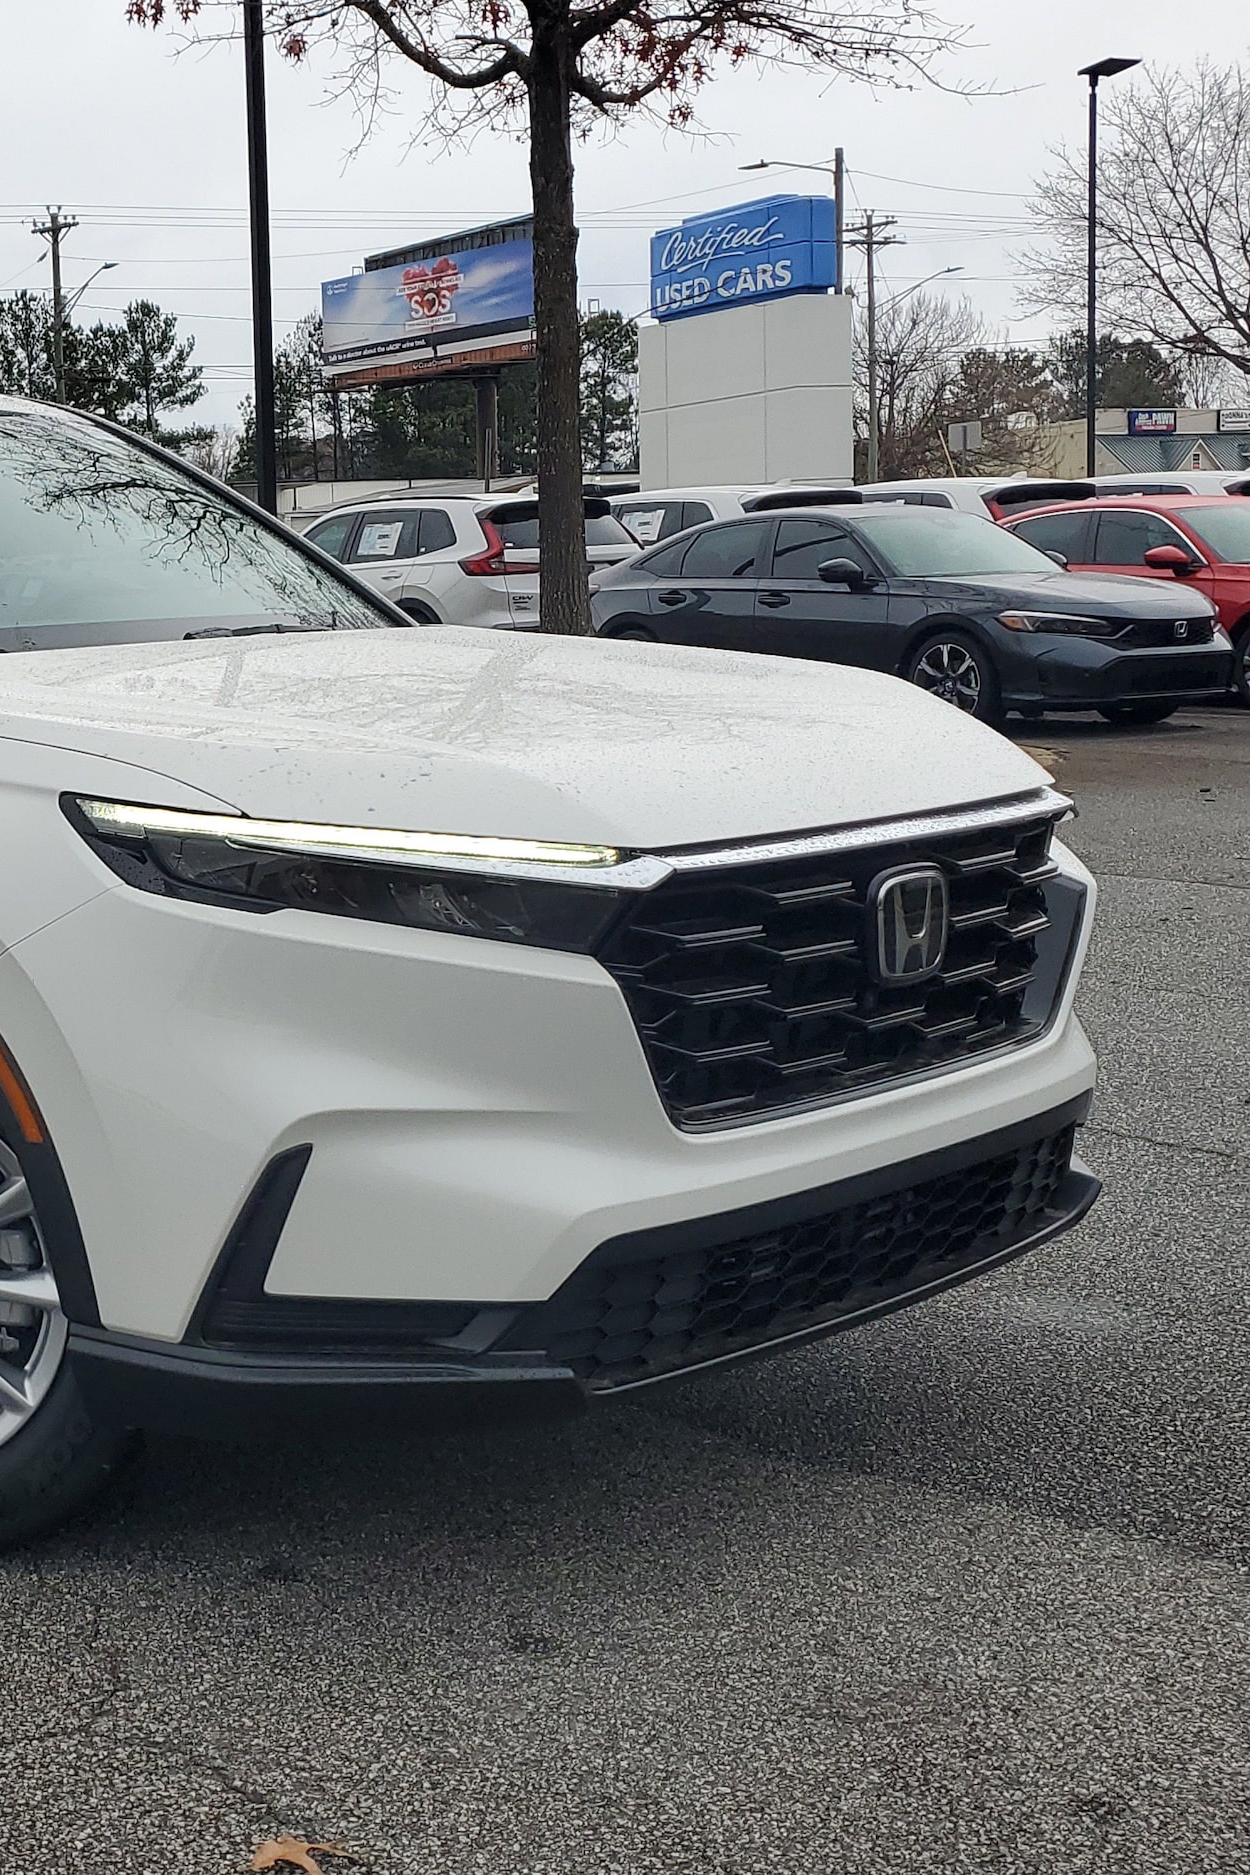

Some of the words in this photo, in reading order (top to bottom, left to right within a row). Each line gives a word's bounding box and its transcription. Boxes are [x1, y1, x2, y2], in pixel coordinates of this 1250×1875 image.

[661, 216, 784, 273] Certified
[411, 290, 450, 318] SOS
[656, 277, 711, 312] USED
[717, 260, 792, 297] CARS
